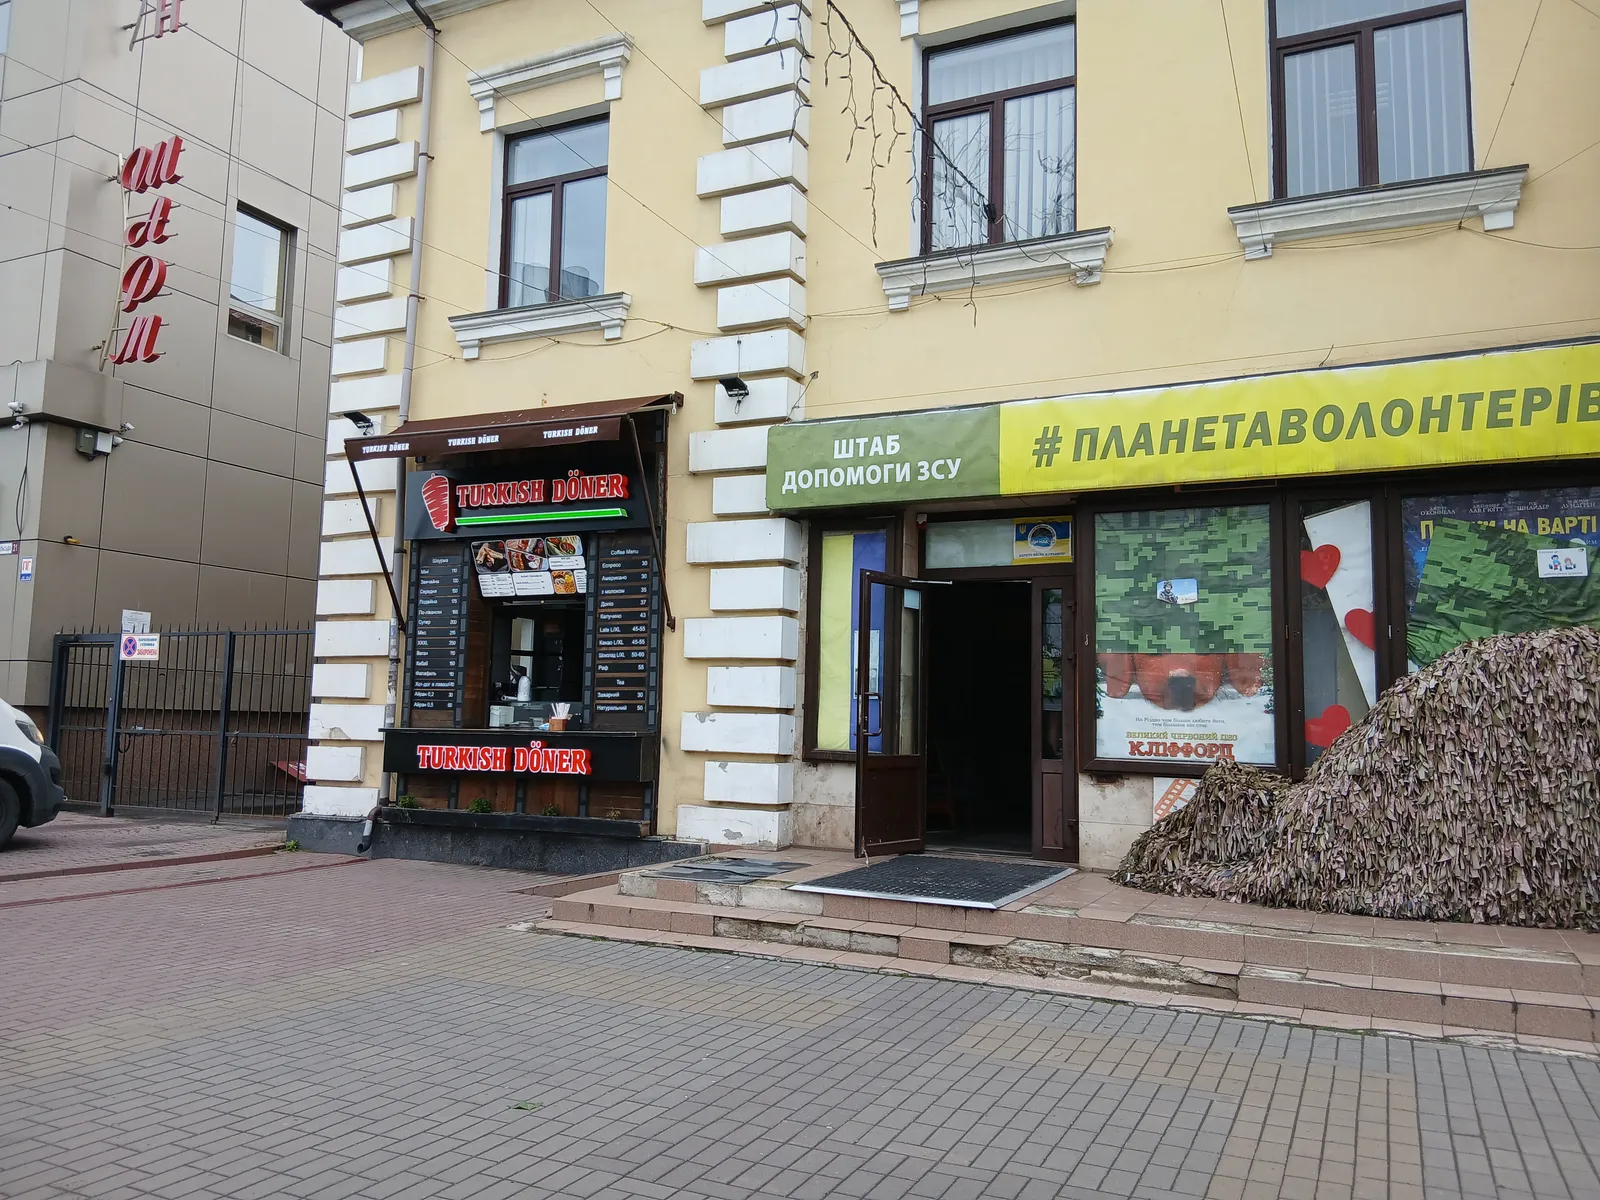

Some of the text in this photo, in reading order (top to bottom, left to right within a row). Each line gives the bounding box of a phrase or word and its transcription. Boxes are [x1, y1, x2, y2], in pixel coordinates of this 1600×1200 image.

[448, 434, 499, 446] TURKISH DÖNER
[543, 425, 598, 439] TURKISH DÖNER
[362, 442, 410, 454] TURKISH DÖNER
[833, 435, 900, 459] ШТАБ
[782, 458, 962, 495] ДОПОМОГИ ЗСУ
[456, 469, 624, 507] TURKISH DÖNER
[1537, 515, 1597, 535] ВАРТІ
[1126, 731, 1168, 740] ВЕЛИКИЙ
[1171, 732, 1218, 741] ЧЕРВОНИЙ
[417, 741, 588, 775] TURKISH DÖNER
[1128, 741, 1235, 761] КЛІФФОРД
